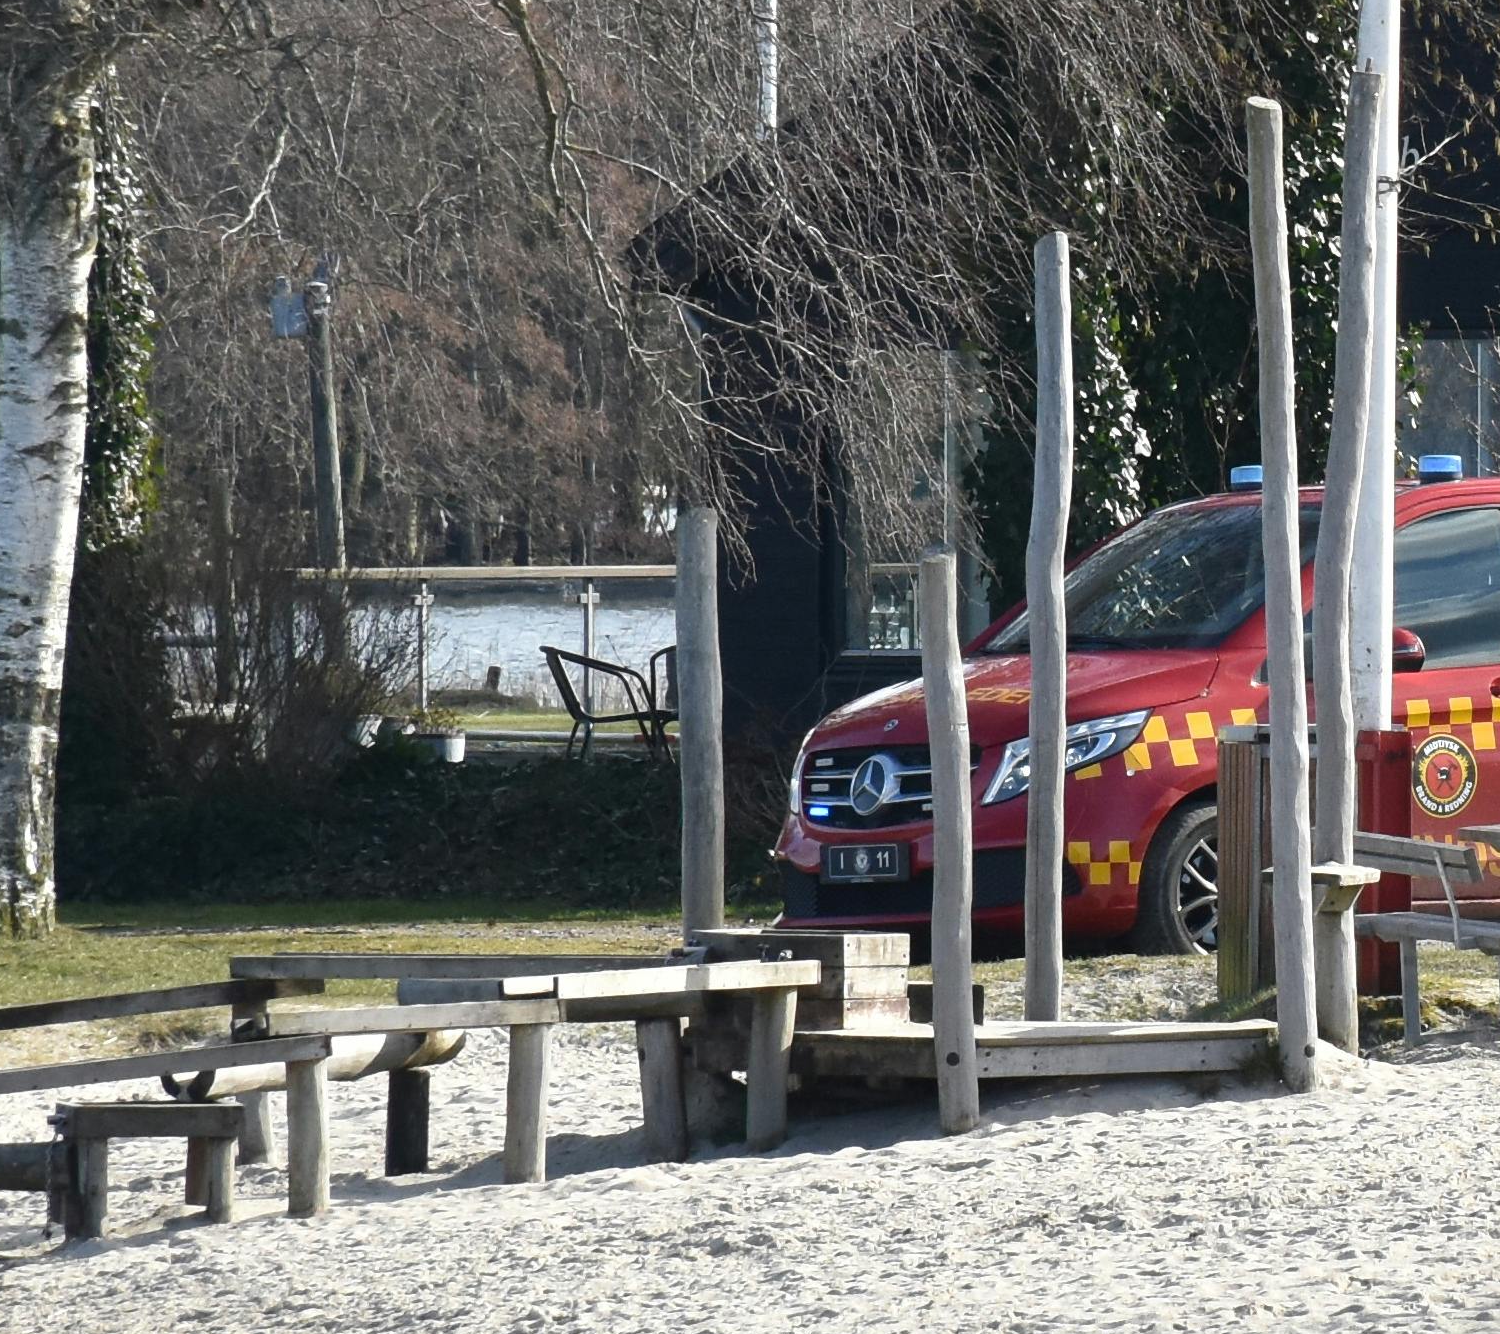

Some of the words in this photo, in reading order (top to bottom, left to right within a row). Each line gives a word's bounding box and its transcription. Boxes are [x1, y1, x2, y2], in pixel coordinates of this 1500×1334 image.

[1415, 785, 1437, 811] BRAND
[1444, 781, 1473, 813] REDNING
[876, 850, 890, 868] 11
